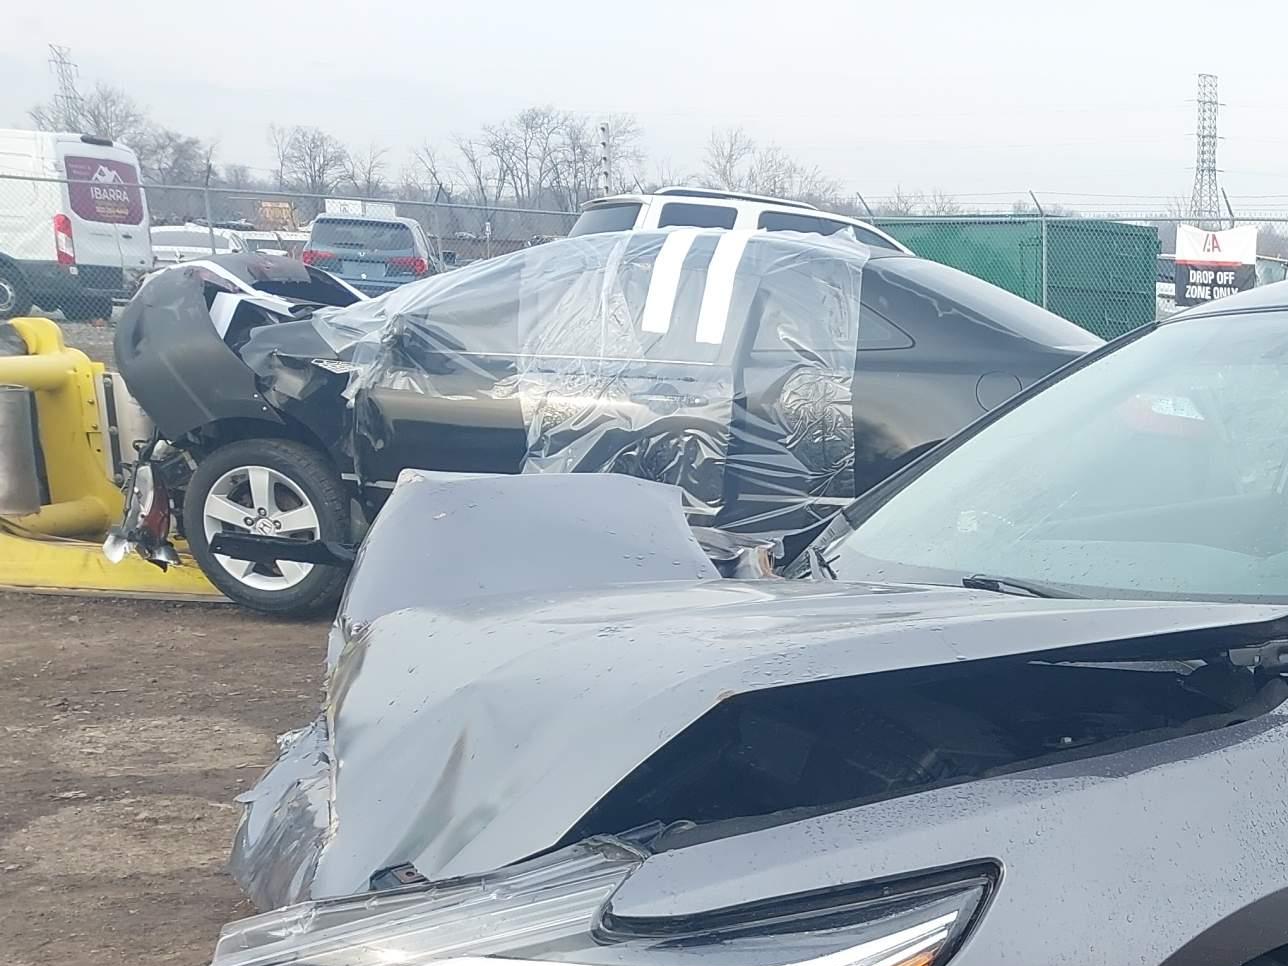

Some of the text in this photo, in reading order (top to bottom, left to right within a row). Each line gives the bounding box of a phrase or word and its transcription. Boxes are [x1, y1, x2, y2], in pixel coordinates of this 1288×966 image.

[90, 187, 129, 202] IBARRA
[1189, 270, 1235, 285] DROP OFF
[1185, 286, 1212, 299] ZONE
